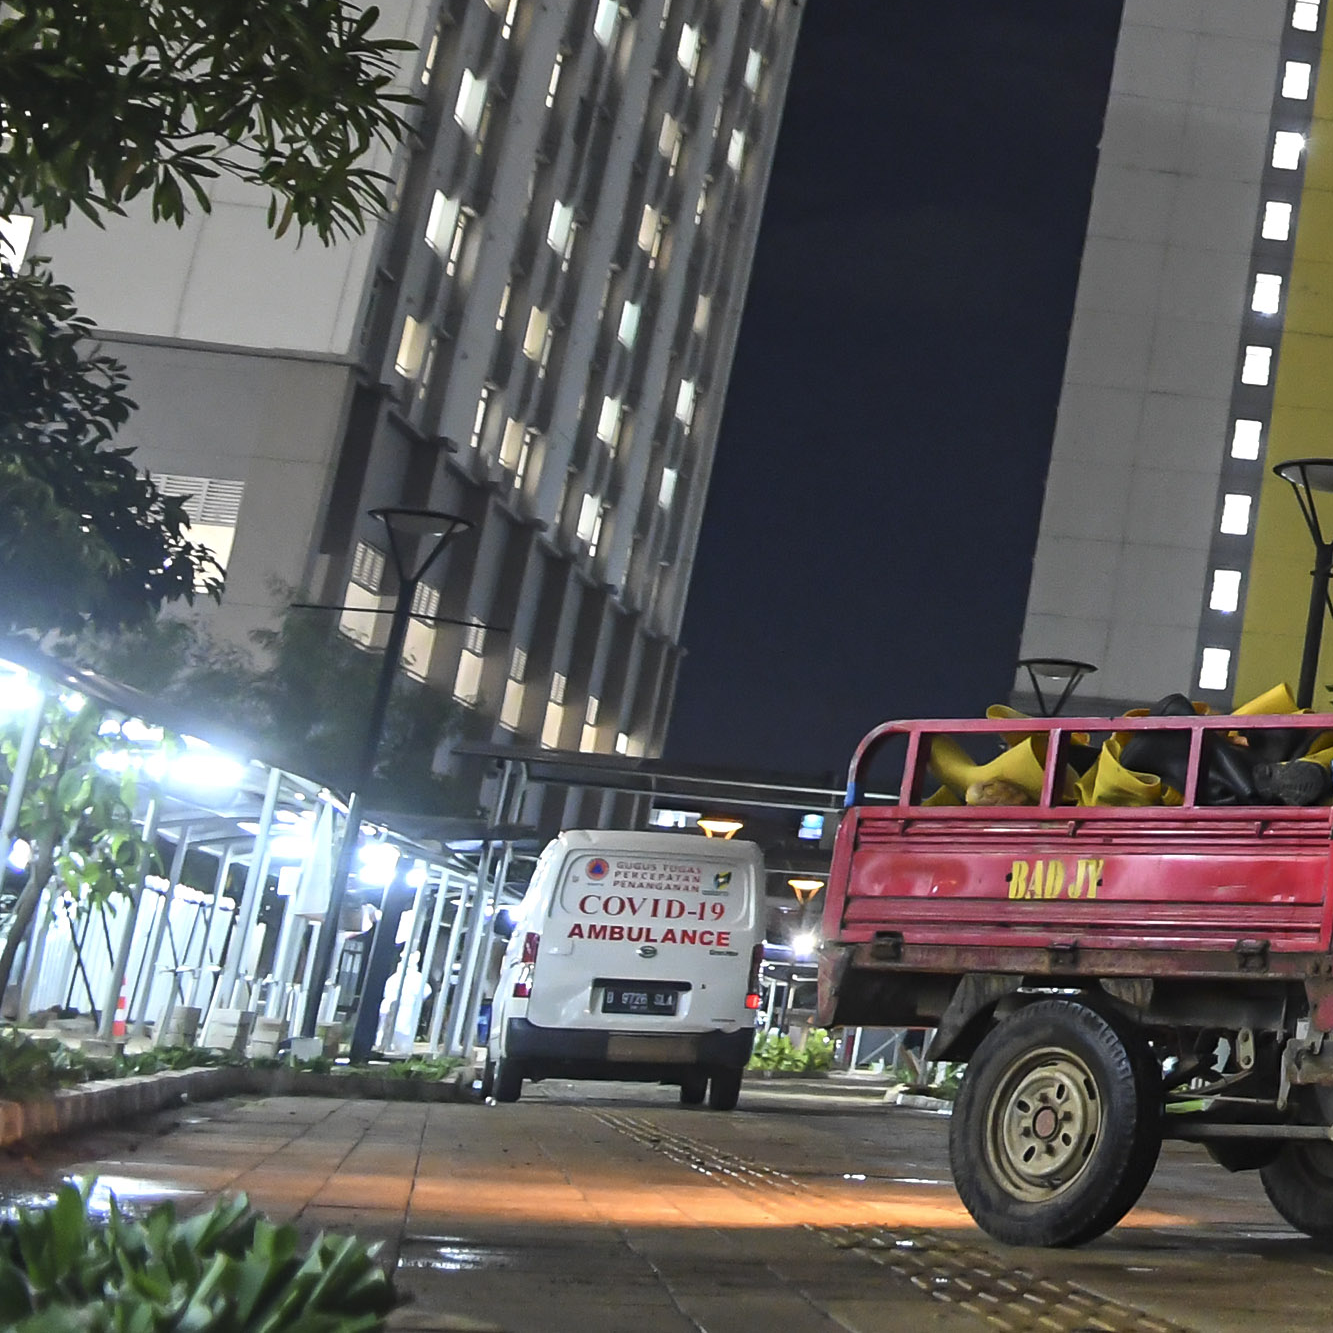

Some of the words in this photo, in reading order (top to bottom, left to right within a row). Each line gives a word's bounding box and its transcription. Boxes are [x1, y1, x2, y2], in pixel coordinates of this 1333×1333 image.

[616, 861, 657, 871] GUGUS
[614, 871, 700, 883] PERCEPATAN
[1009, 860, 1065, 899] BAD
[1068, 859, 1104, 899] JY
[613, 880, 699, 893] PENANGANAN
[579, 894, 725, 921] COVID-19
[568, 923, 731, 947] AMBULANCE
